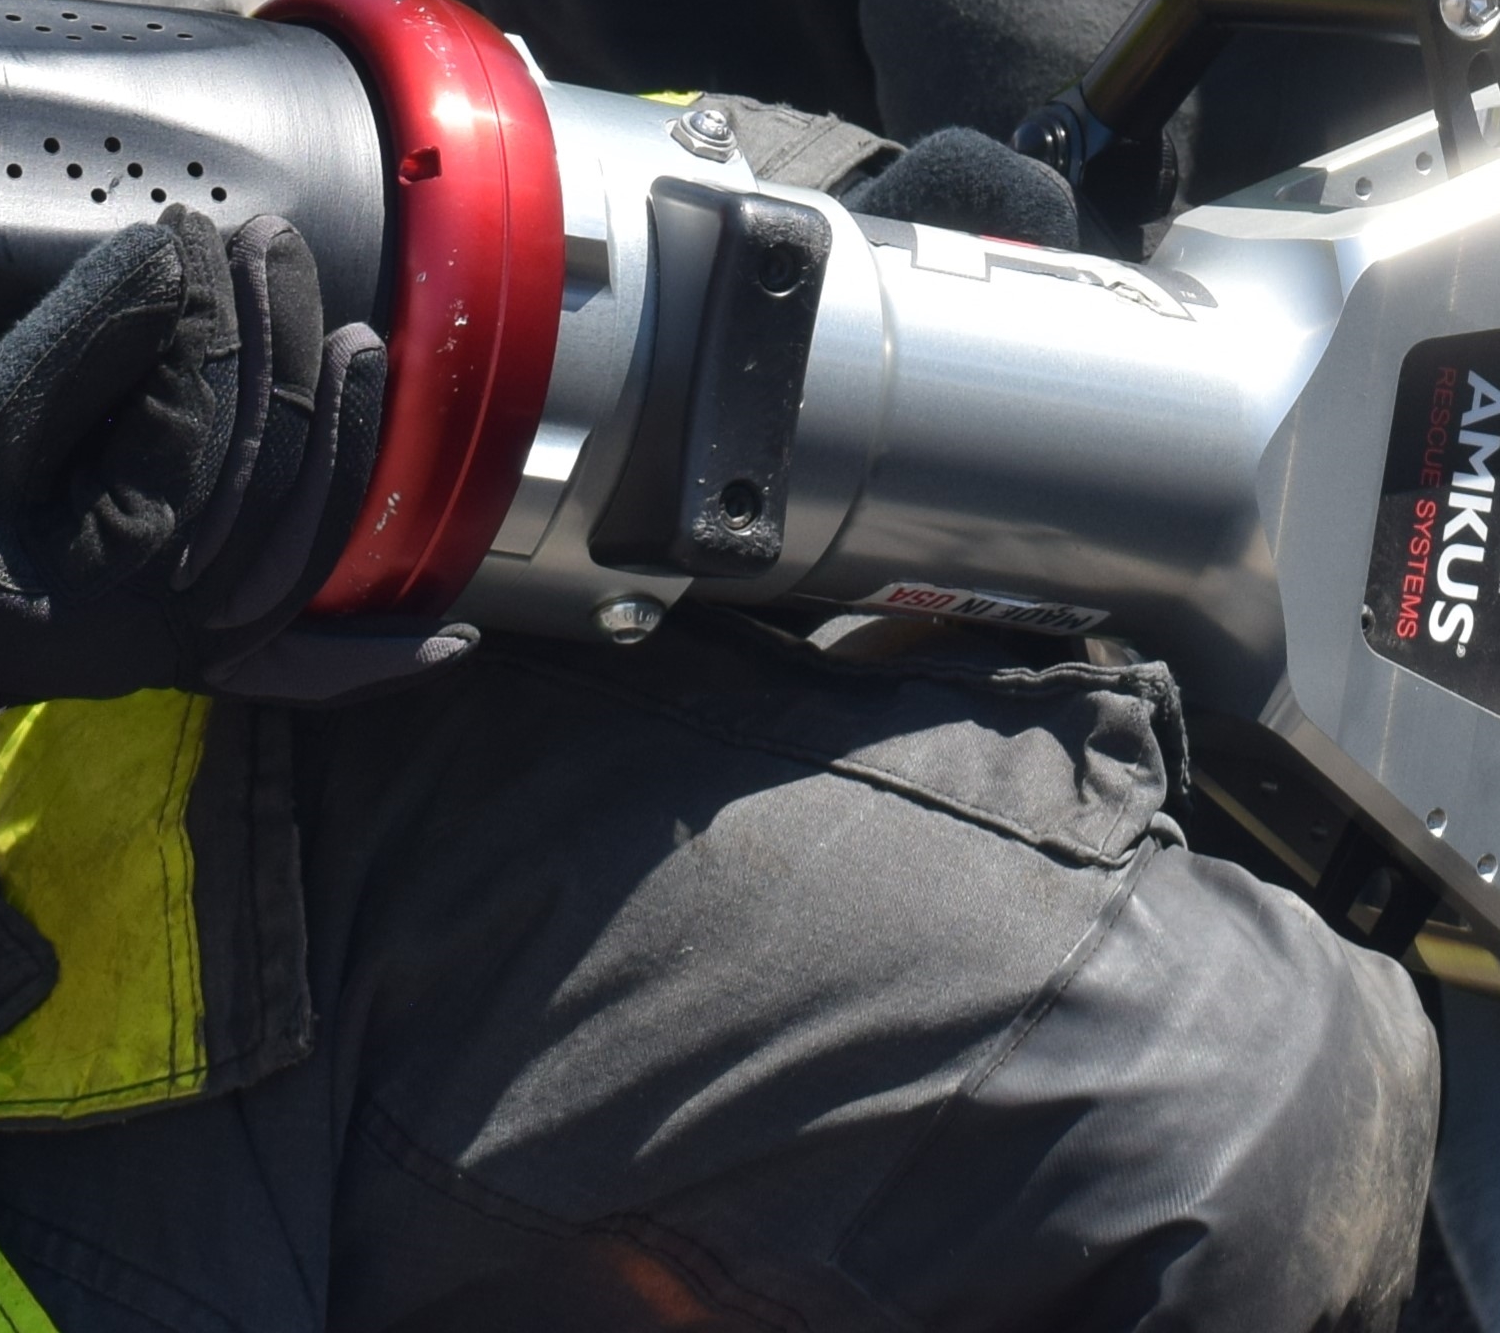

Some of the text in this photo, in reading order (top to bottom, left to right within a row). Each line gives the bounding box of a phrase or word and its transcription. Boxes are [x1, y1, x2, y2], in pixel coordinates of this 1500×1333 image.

[1396, 365, 1457, 640] RESCUE SYSTEMS
[887, 587, 1092, 630] MADE IN USA
